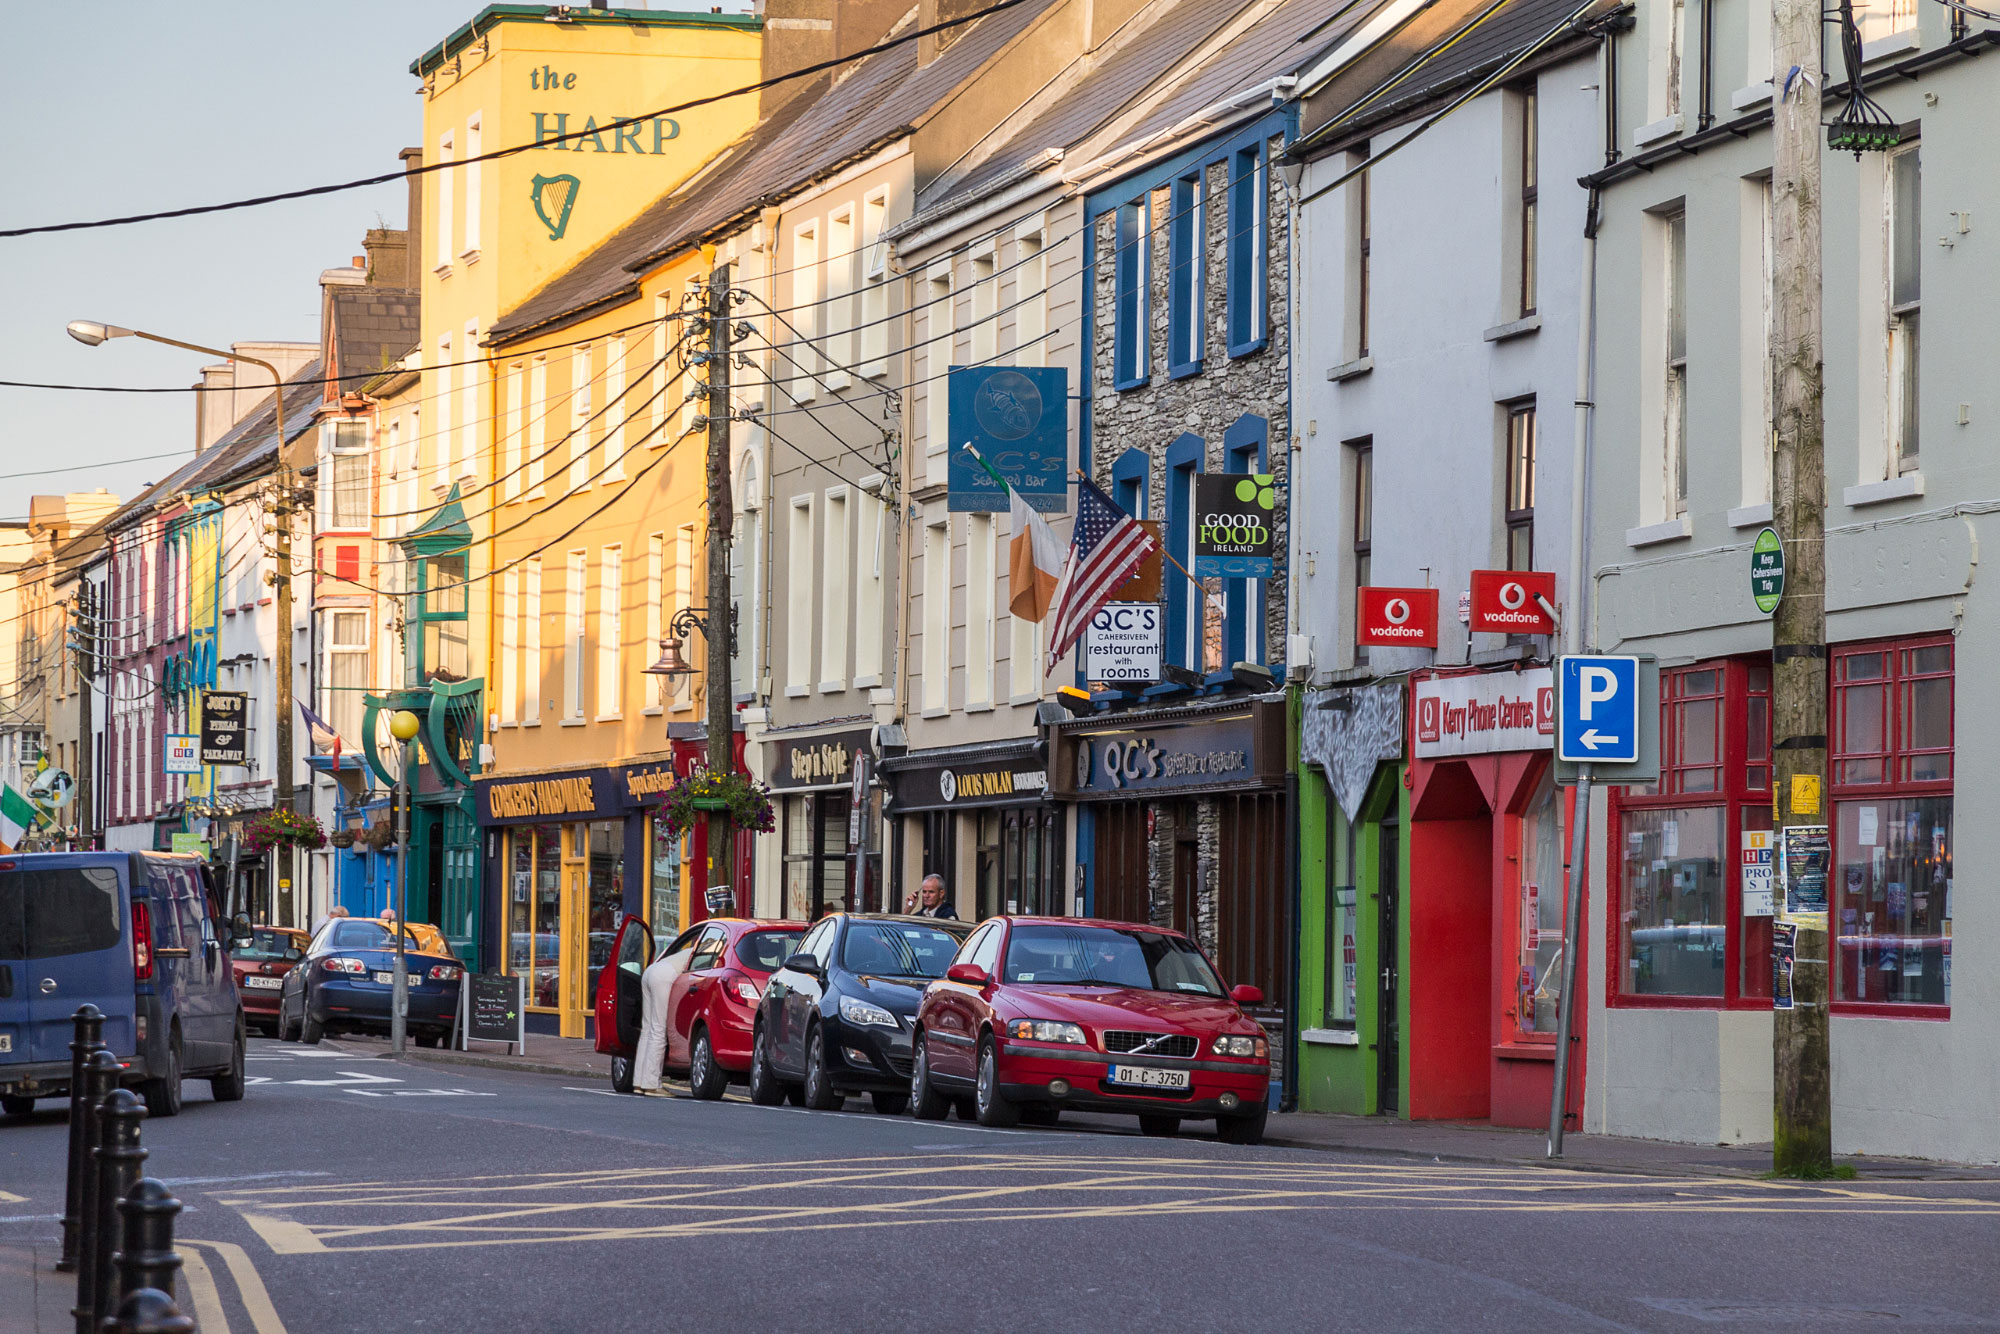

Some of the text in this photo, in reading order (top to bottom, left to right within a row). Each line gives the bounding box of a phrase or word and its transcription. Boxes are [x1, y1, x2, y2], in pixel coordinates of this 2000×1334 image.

[530, 65, 577, 90] the
[530, 112, 681, 155] HARP
[1025, 473, 1047, 487] Bar
[1205, 513, 1260, 528] GOOD
[1200, 525, 1269, 545] FOOD
[1198, 560, 1269, 575] QC's
[1760, 554, 1774, 567] Keep
[1752, 567, 1783, 579] Cahersiveen
[1762, 579, 1774, 593] Tidy
[1091, 609, 1155, 632] QC'S
[1484, 611, 1540, 624] vodafone
[1097, 633, 1149, 641] CAHERSIVEEN
[1370, 626, 1424, 638] vodafone
[1088, 643, 1159, 655] restaurant
[1114, 657, 1132, 665] with
[1100, 667, 1150, 679] rooms
[1580, 666, 1619, 721] P
[206, 695, 242, 711] JOEY'S
[1443, 695, 1534, 741] Kerry Phone Centres
[215, 734, 233, 746] &
[822, 741, 848, 784] Style
[1104, 738, 1161, 788] QC's
[957, 773, 983, 797] LOUIS
[983, 771, 1013, 795] NOLAN
[536, 776, 596, 817] HARDWARE
[1751, 832, 1765, 847] T
